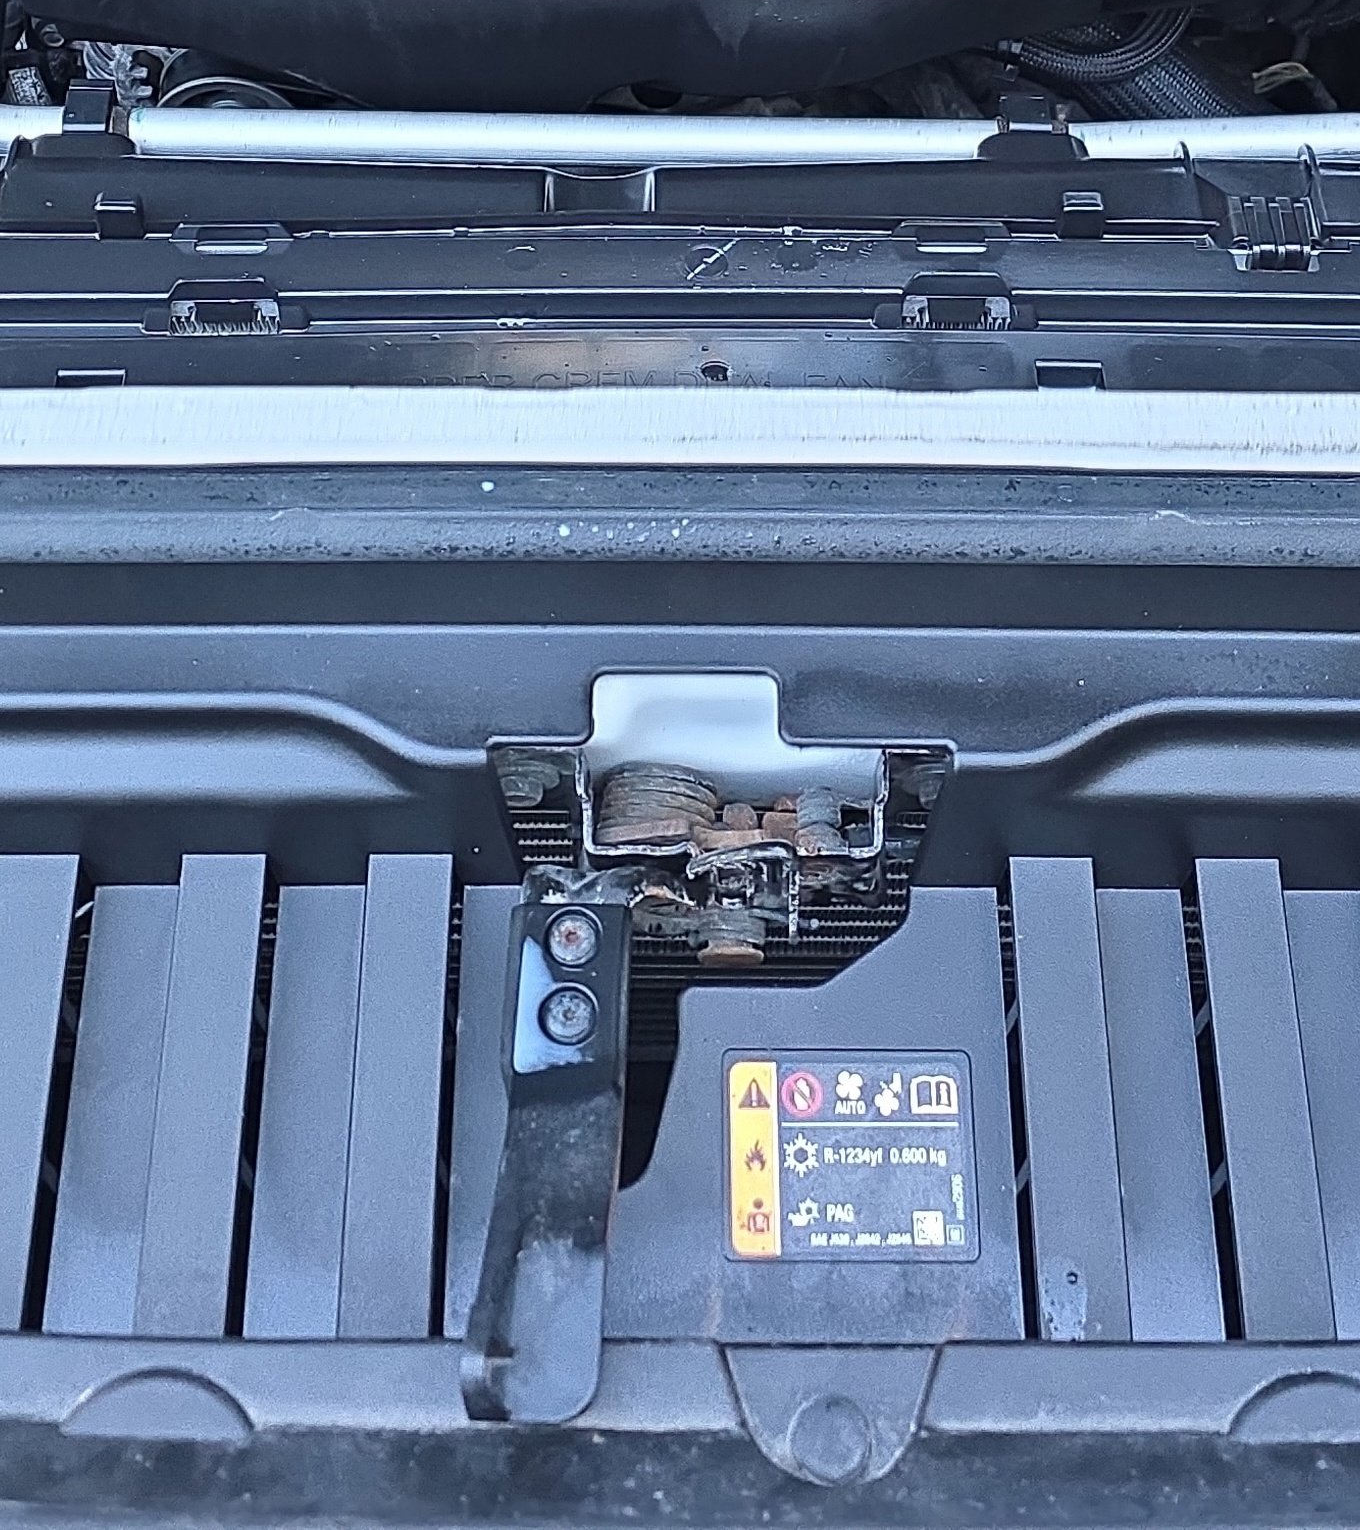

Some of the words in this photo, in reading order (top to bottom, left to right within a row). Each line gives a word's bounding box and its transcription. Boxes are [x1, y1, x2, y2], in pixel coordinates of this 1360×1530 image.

[834, 1100, 866, 1115] AUTO
[929, 1147, 947, 1167] kg
[826, 1204, 855, 1222] PAG
